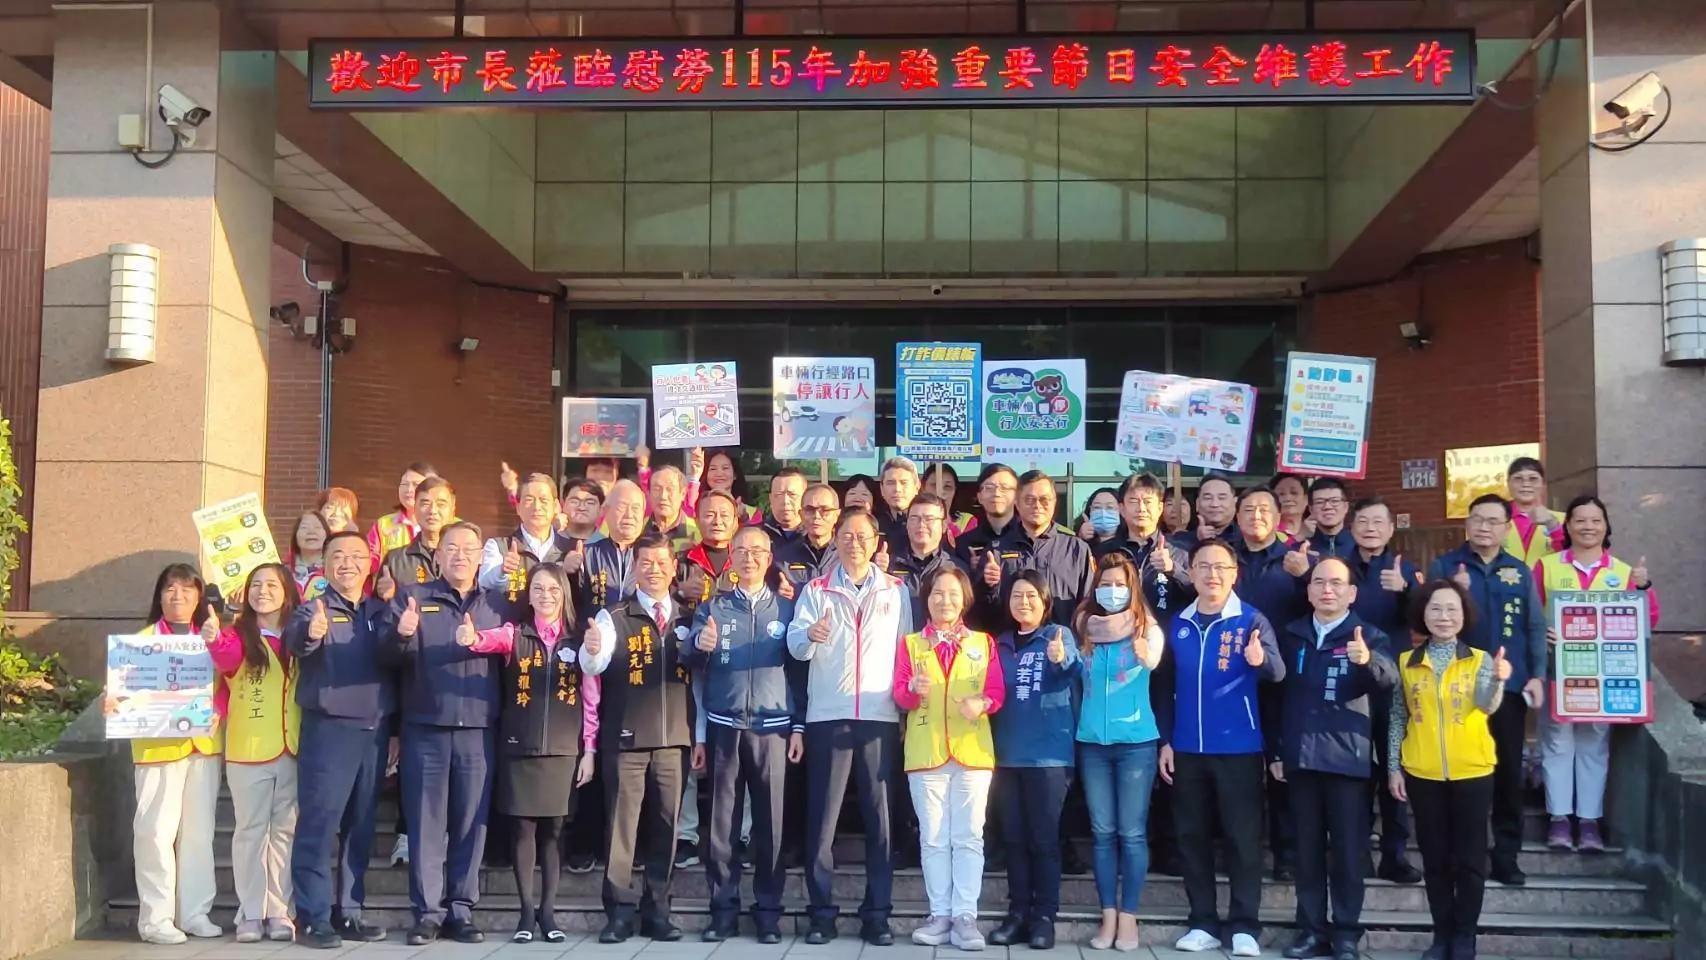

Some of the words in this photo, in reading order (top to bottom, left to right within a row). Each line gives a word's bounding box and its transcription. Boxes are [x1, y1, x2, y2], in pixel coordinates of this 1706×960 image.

[781, 365, 870, 380] 車輛行經路口
[797, 382, 870, 400] 停讓行人
[1000, 415, 1069, 430] 行人安全行
[1016, 652, 1035, 700] 邱若華
